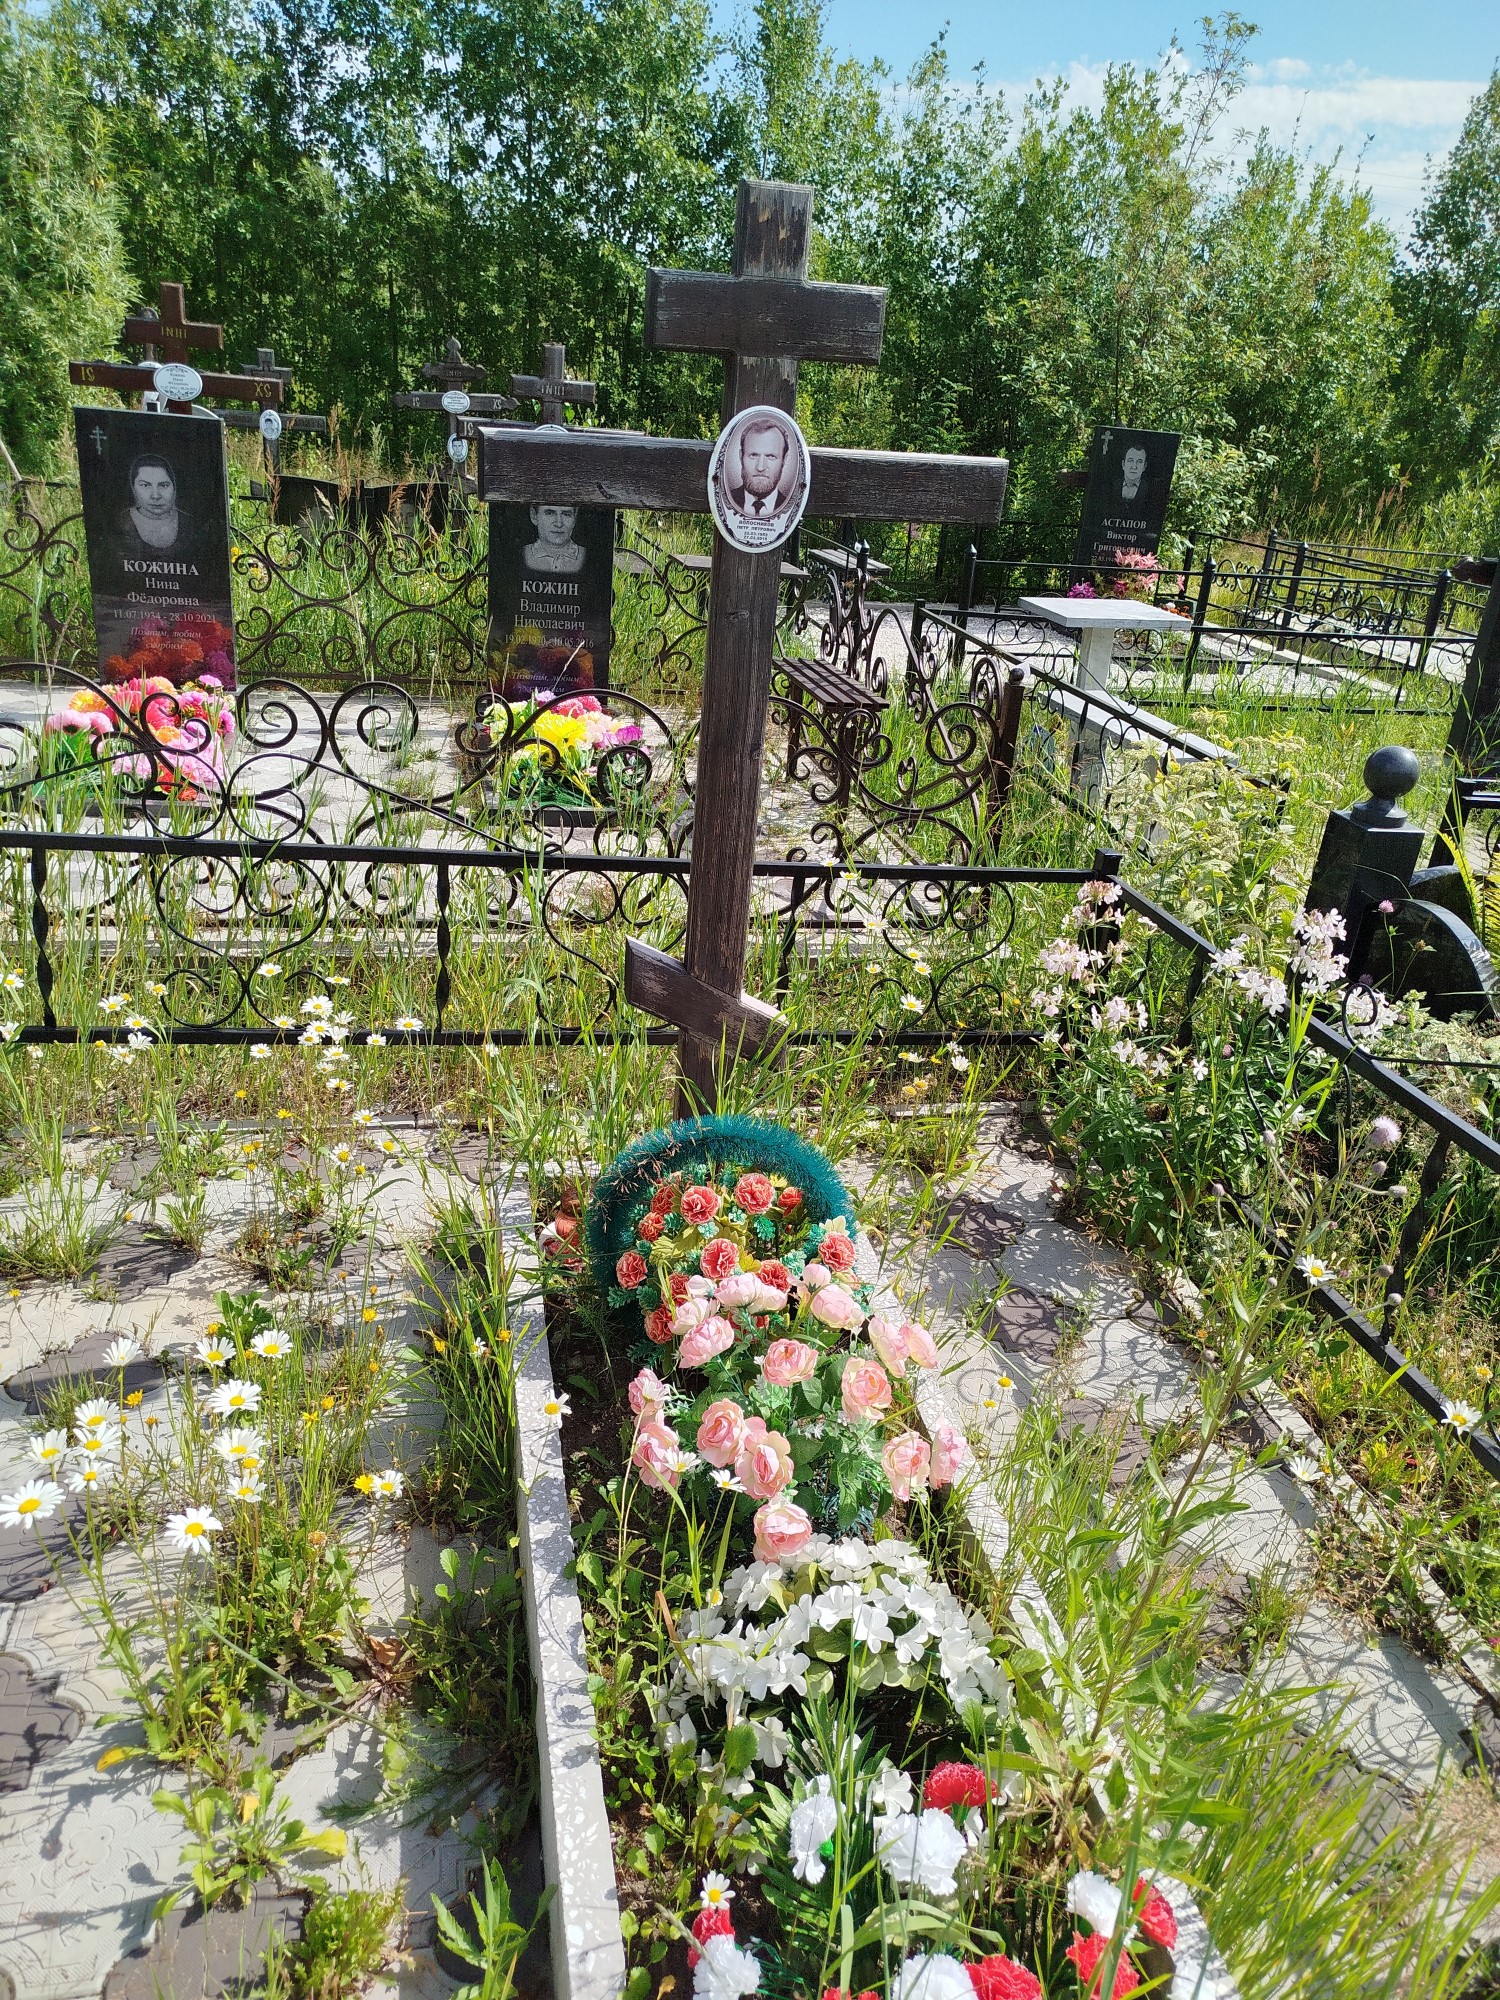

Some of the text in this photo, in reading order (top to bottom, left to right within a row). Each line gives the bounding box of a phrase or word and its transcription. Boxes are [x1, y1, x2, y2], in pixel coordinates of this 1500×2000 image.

[1101, 518, 1147, 529] АСТАПОВ
[1106, 530, 1137, 543] Виктор
[123, 560, 200, 575] КОЖИНА
[145, 577, 180, 590] Нина
[521, 580, 579, 595] КОЖИН
[127, 591, 200, 607] Фёдоровна
[520, 598, 581, 618] Владимир
[113, 609, 161, 620] 11.07.1934
[168, 612, 216, 624] 28.10.2021
[514, 614, 585, 630] Николаевич
